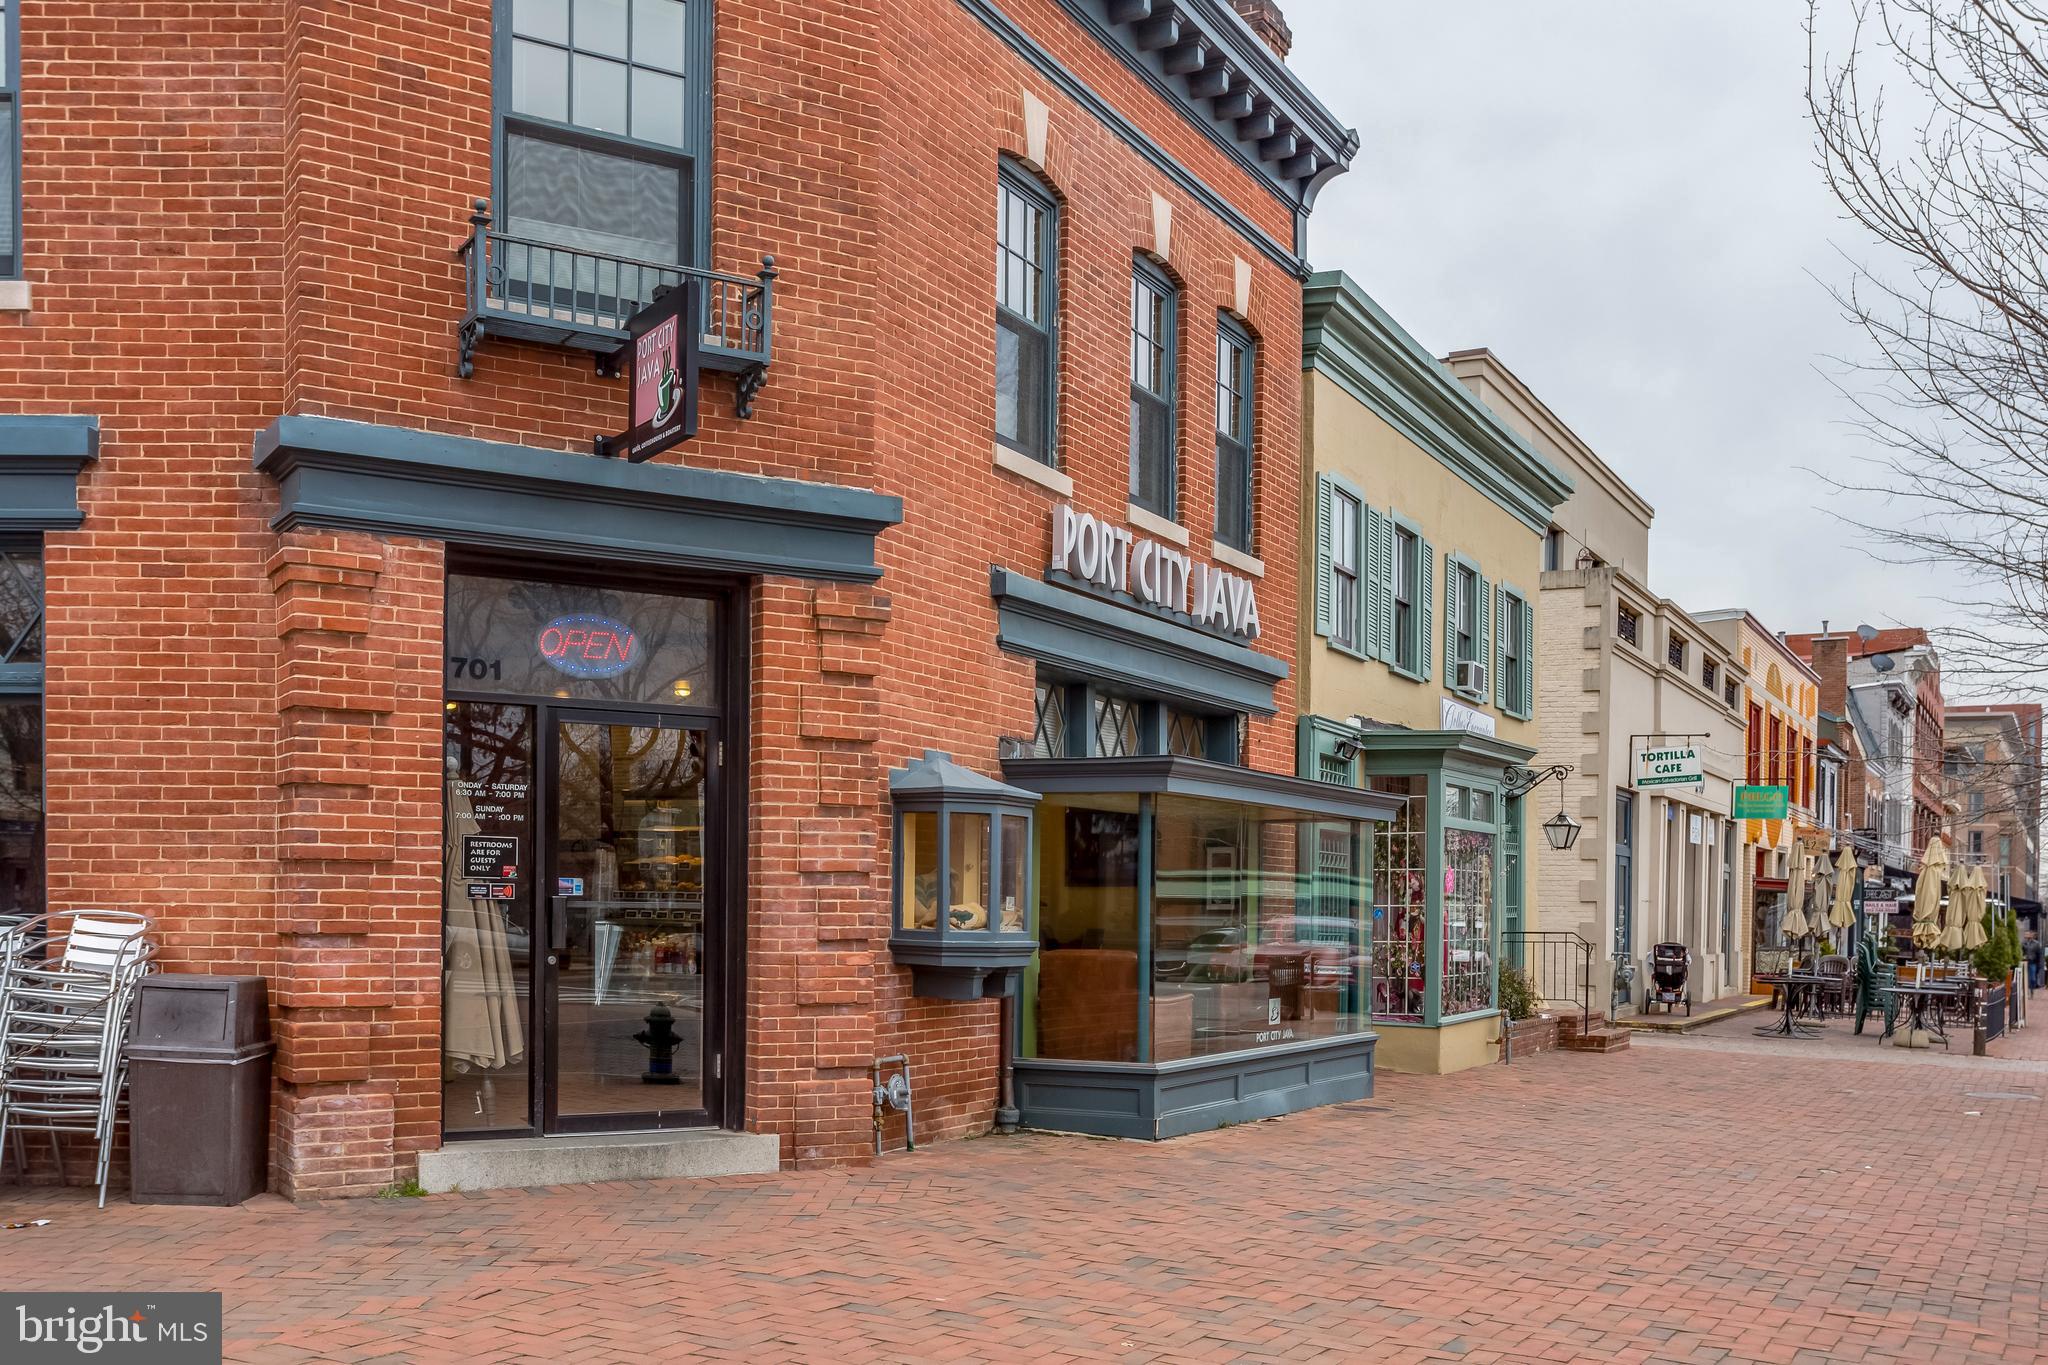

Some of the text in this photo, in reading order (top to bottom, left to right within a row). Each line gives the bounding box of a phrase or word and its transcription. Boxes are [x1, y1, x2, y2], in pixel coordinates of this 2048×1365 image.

[636, 322, 675, 362] PORT CITY
[636, 358, 661, 389] JAVA
[1051, 503, 1261, 639] PORT CITY JAVA
[538, 627, 635, 662] OPEN
[451, 656, 502, 681] 701
[1640, 750, 1696, 762] TORTILLA
[1654, 763, 1682, 774] CAFE
[451, 781, 482, 789] ONDAY
[491, 782, 528, 791] SATURDAY
[455, 788, 472, 796] 6:30
[513, 791, 525, 799] PM
[475, 805, 505, 813] SUNDAY
[513, 814, 525, 822] PM
[470, 841, 513, 849] RESTROOMS
[1256, 1028, 1294, 1043] PORT CITY JAVA
